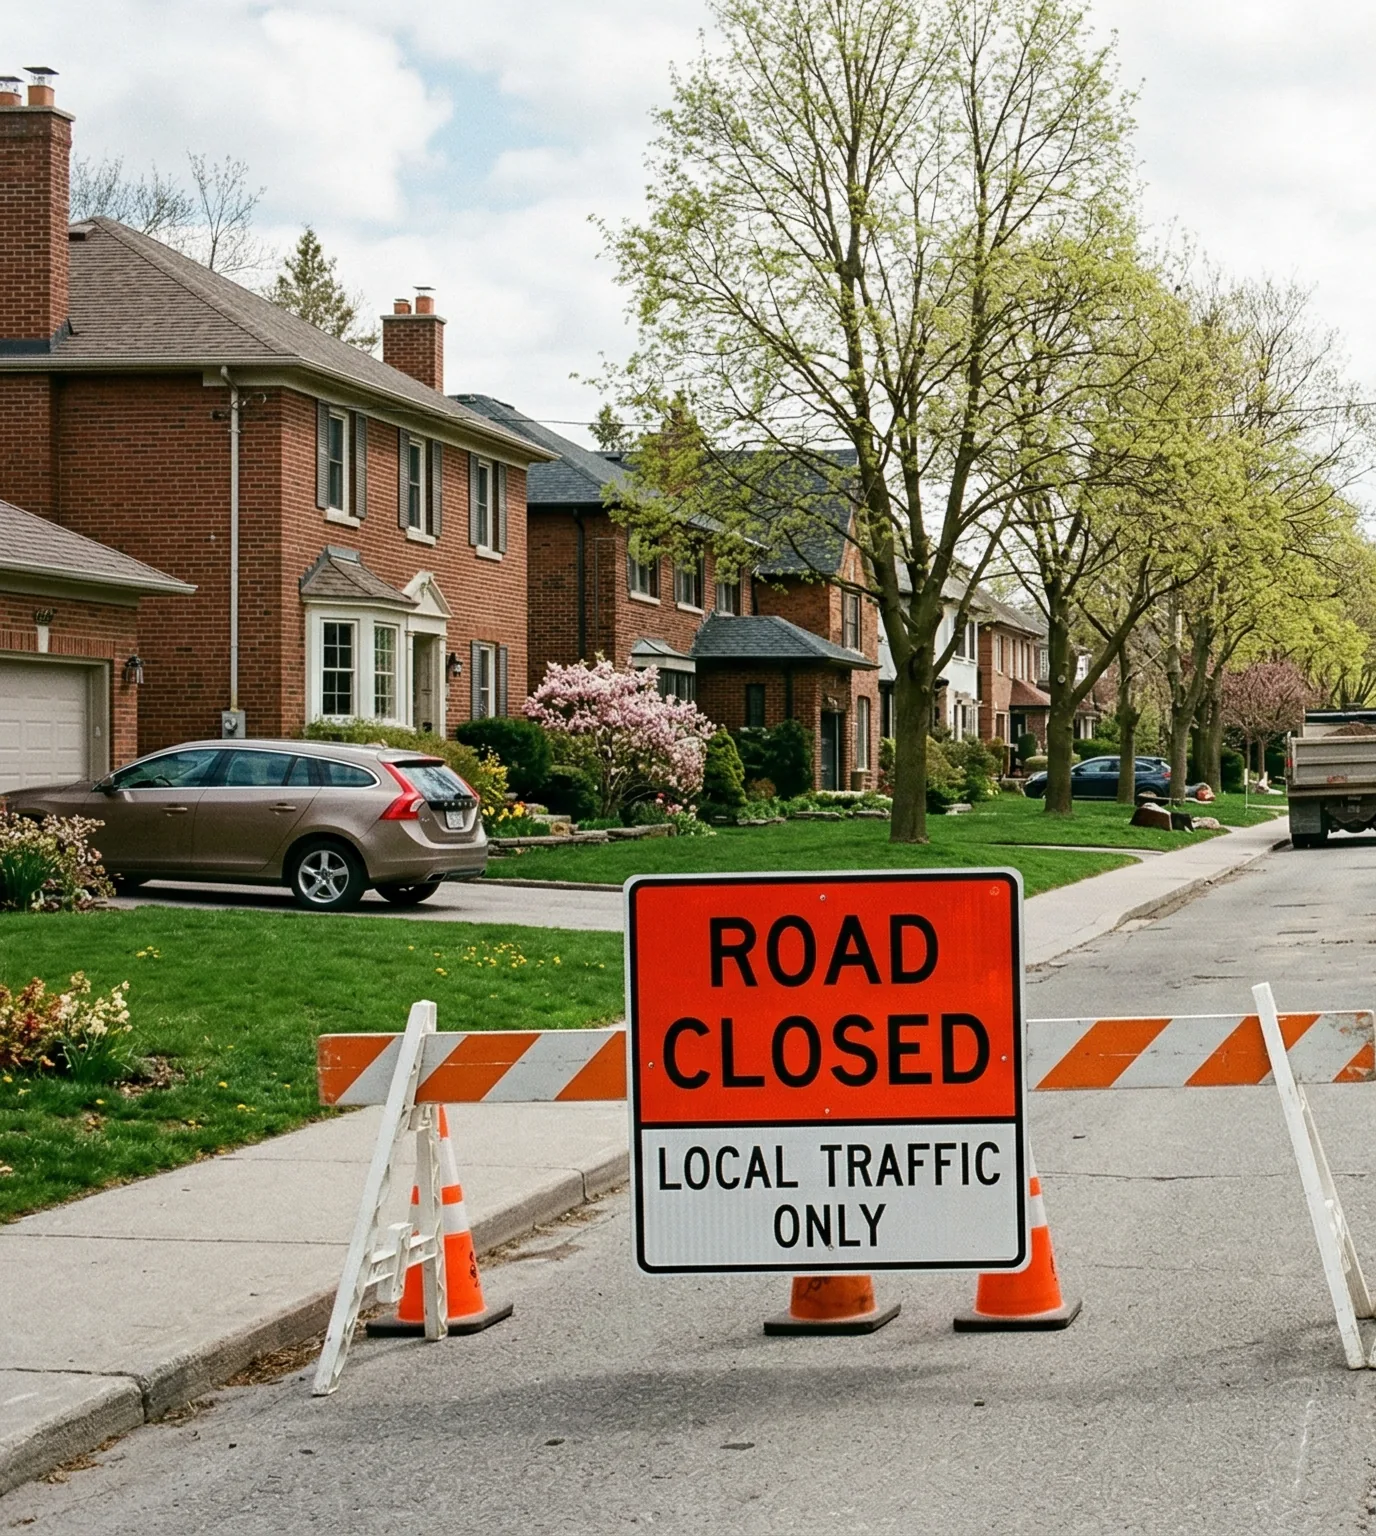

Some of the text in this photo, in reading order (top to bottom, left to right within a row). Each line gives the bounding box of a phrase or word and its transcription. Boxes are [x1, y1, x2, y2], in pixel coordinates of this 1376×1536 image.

[709, 913, 939, 988] ROAD
[662, 1013, 990, 1090] CLOSED
[658, 1141, 1001, 1191] LOCAL TRAFFIC
[773, 1203, 887, 1249] ONLY
